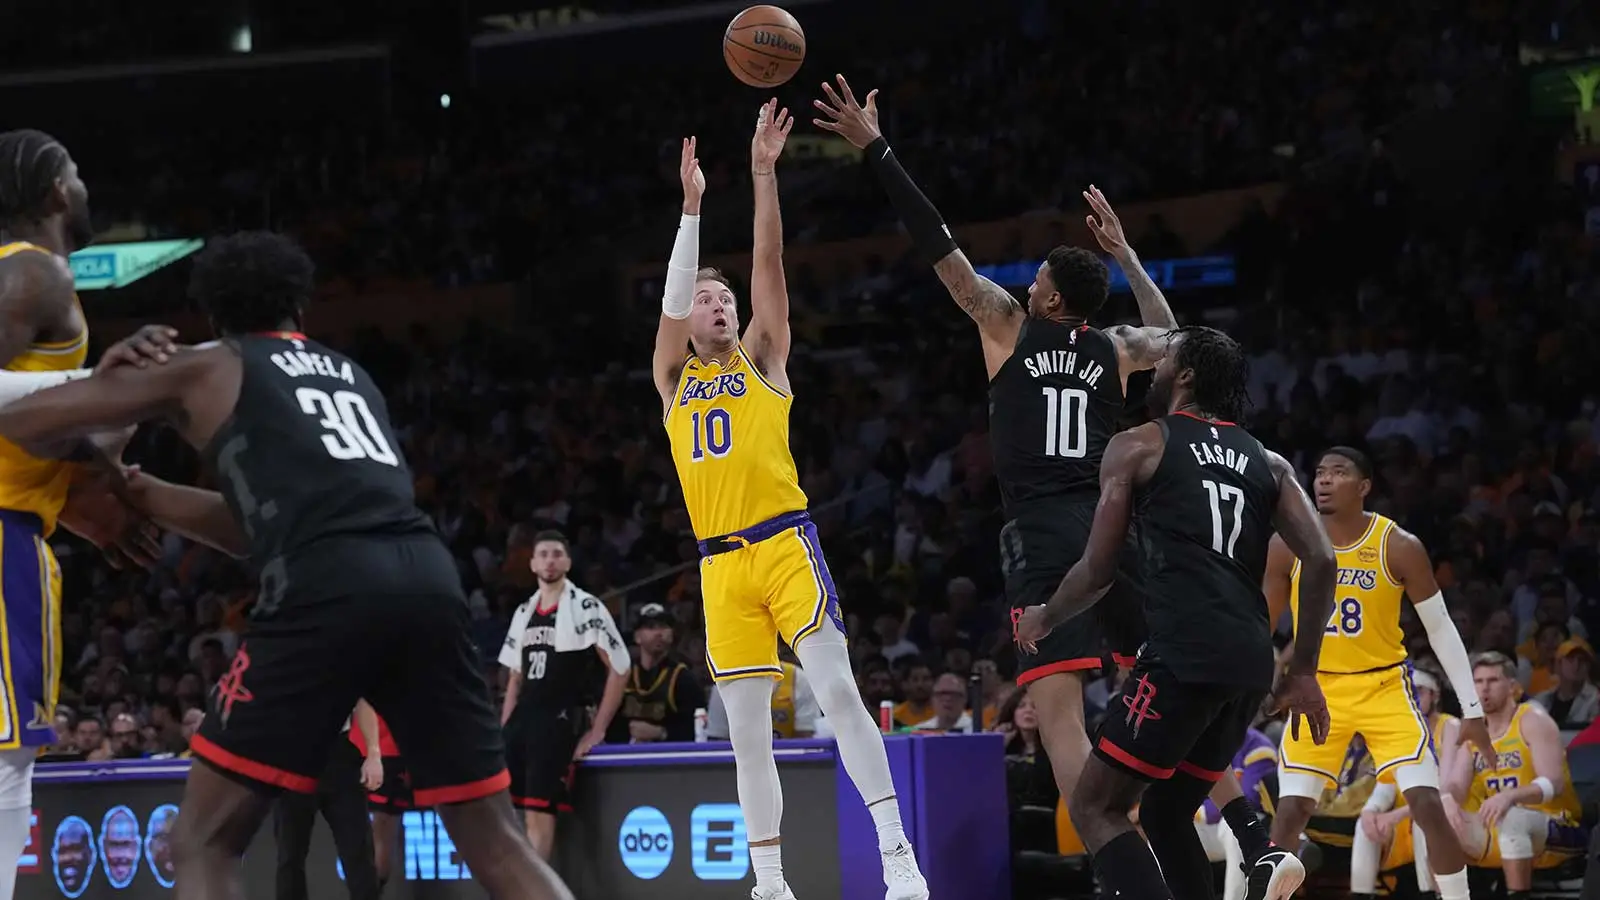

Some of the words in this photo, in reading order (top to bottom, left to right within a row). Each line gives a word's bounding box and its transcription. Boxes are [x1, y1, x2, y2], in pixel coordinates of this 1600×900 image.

[754, 30, 801, 54] Wilson
[270, 350, 355, 384] CAPELA
[1024, 350, 1077, 378] SMITH
[1078, 359, 1104, 390] JR.
[679, 372, 747, 407] LAKERS
[295, 386, 399, 467] 30
[692, 407, 732, 462] 10
[1042, 386, 1088, 458] 10
[1189, 442, 1249, 475] EASON
[1202, 479, 1245, 559] 17
[1337, 568, 1378, 591] ERS
[521, 627, 556, 647] OUSTO
[527, 651, 548, 680] 28
[402, 811, 473, 880] NE
[624, 828, 669, 852] abc
